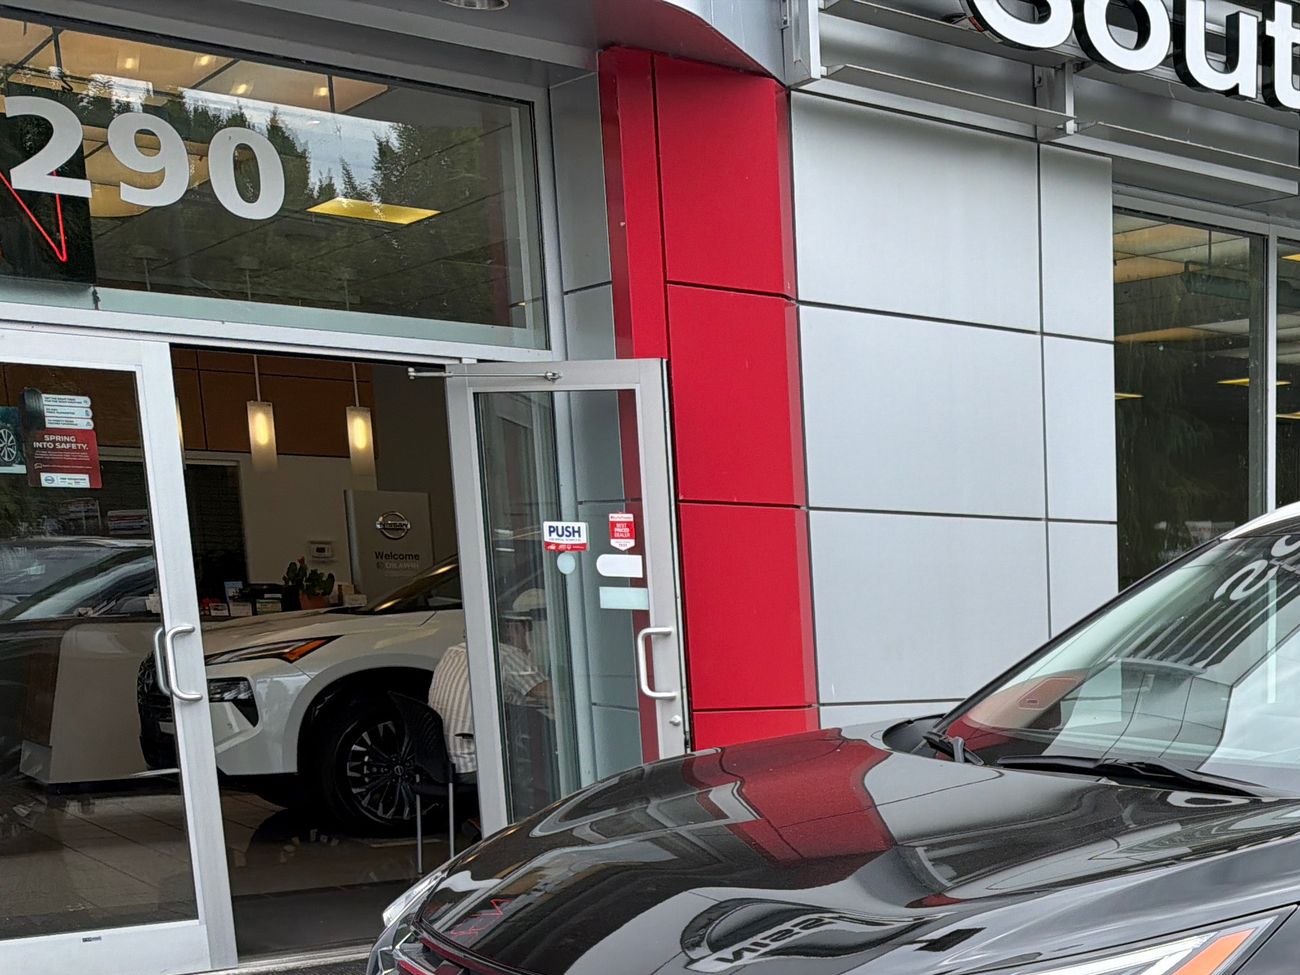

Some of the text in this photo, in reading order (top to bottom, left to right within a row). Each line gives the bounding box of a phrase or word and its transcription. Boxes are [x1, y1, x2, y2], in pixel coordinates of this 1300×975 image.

[5, 96, 285, 220] 290
[44, 434, 76, 442] SPRING
[55, 442, 89, 450] SAFETY.
[548, 525, 581, 538] PUSH
[374, 551, 420, 561] Welcome
